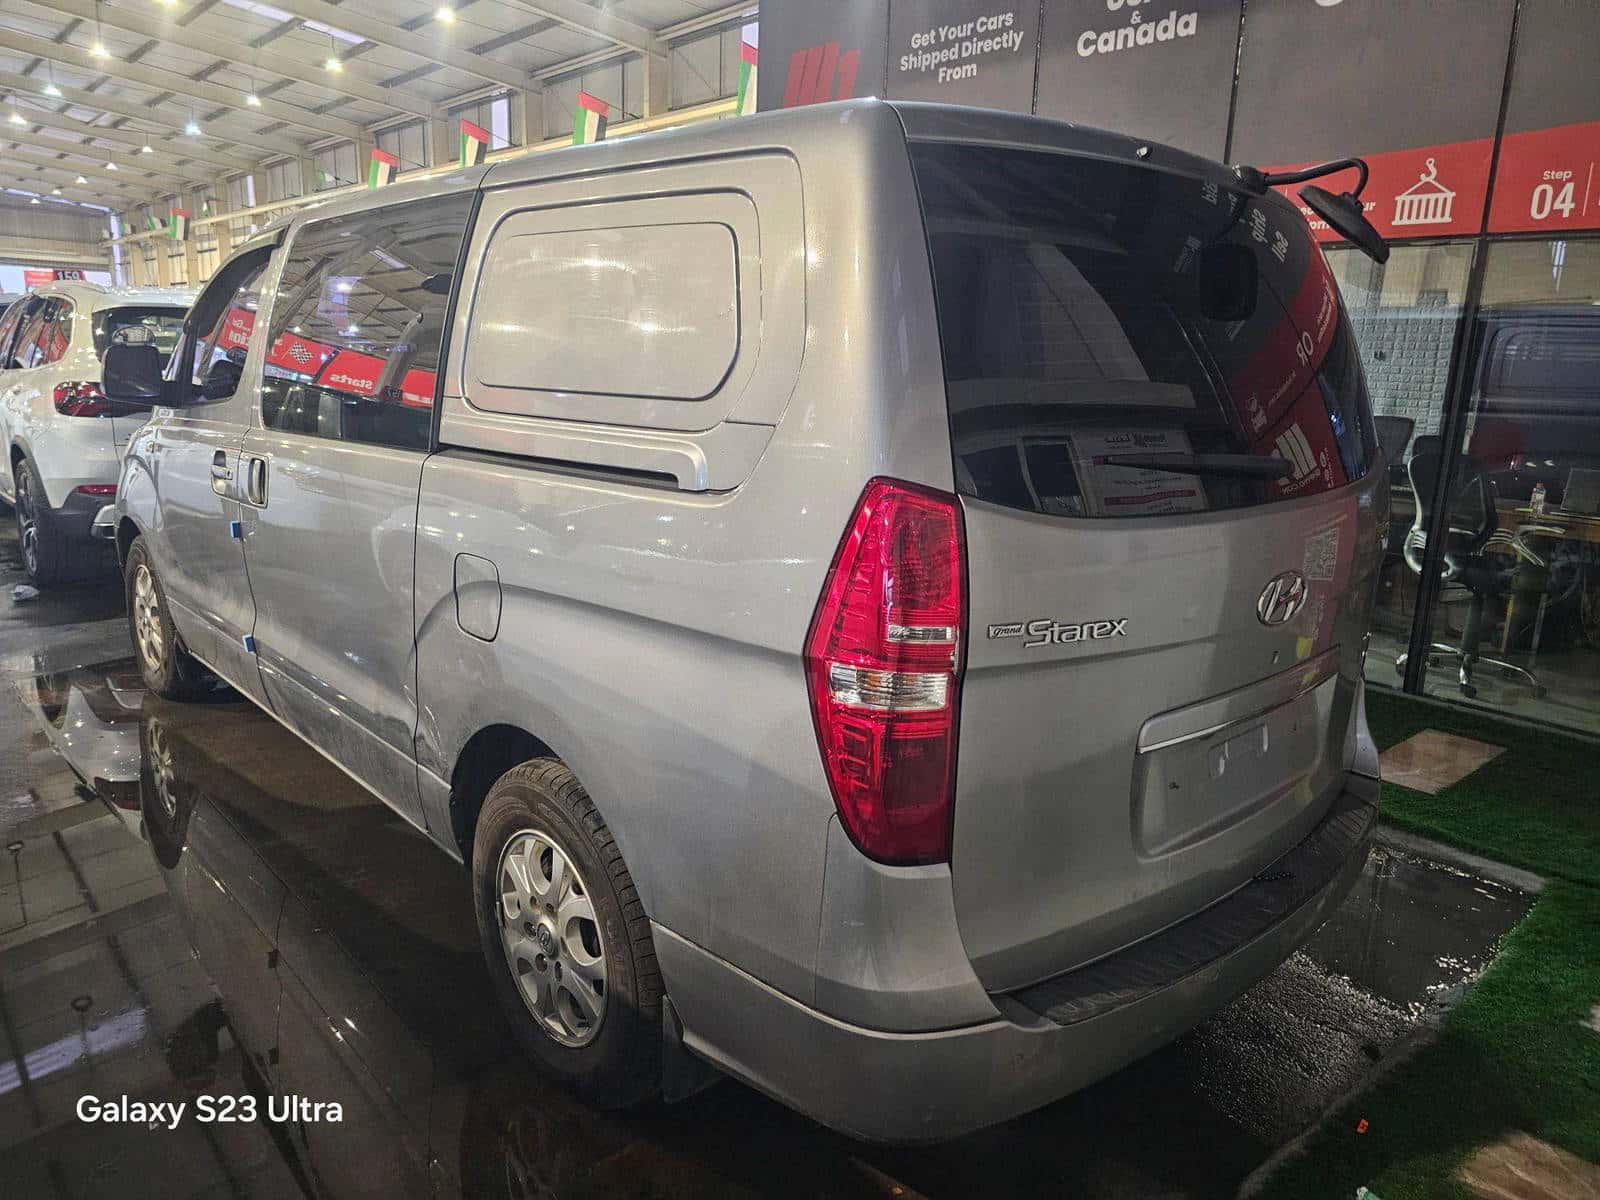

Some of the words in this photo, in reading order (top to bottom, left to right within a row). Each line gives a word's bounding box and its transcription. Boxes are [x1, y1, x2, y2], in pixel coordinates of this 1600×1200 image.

[911, 30, 937, 49] Get
[938, 20, 974, 42] Your
[976, 12, 1014, 33] Cars
[1131, 10, 1142, 24] &
[1076, 10, 1199, 57] Canada
[900, 42, 960, 73] Shipped
[961, 30, 1024, 59] Directly
[938, 62, 978, 83] From
[1543, 169, 1572, 182] Step
[1530, 181, 1576, 220] 04
[1025, 620, 1128, 648] Starex
